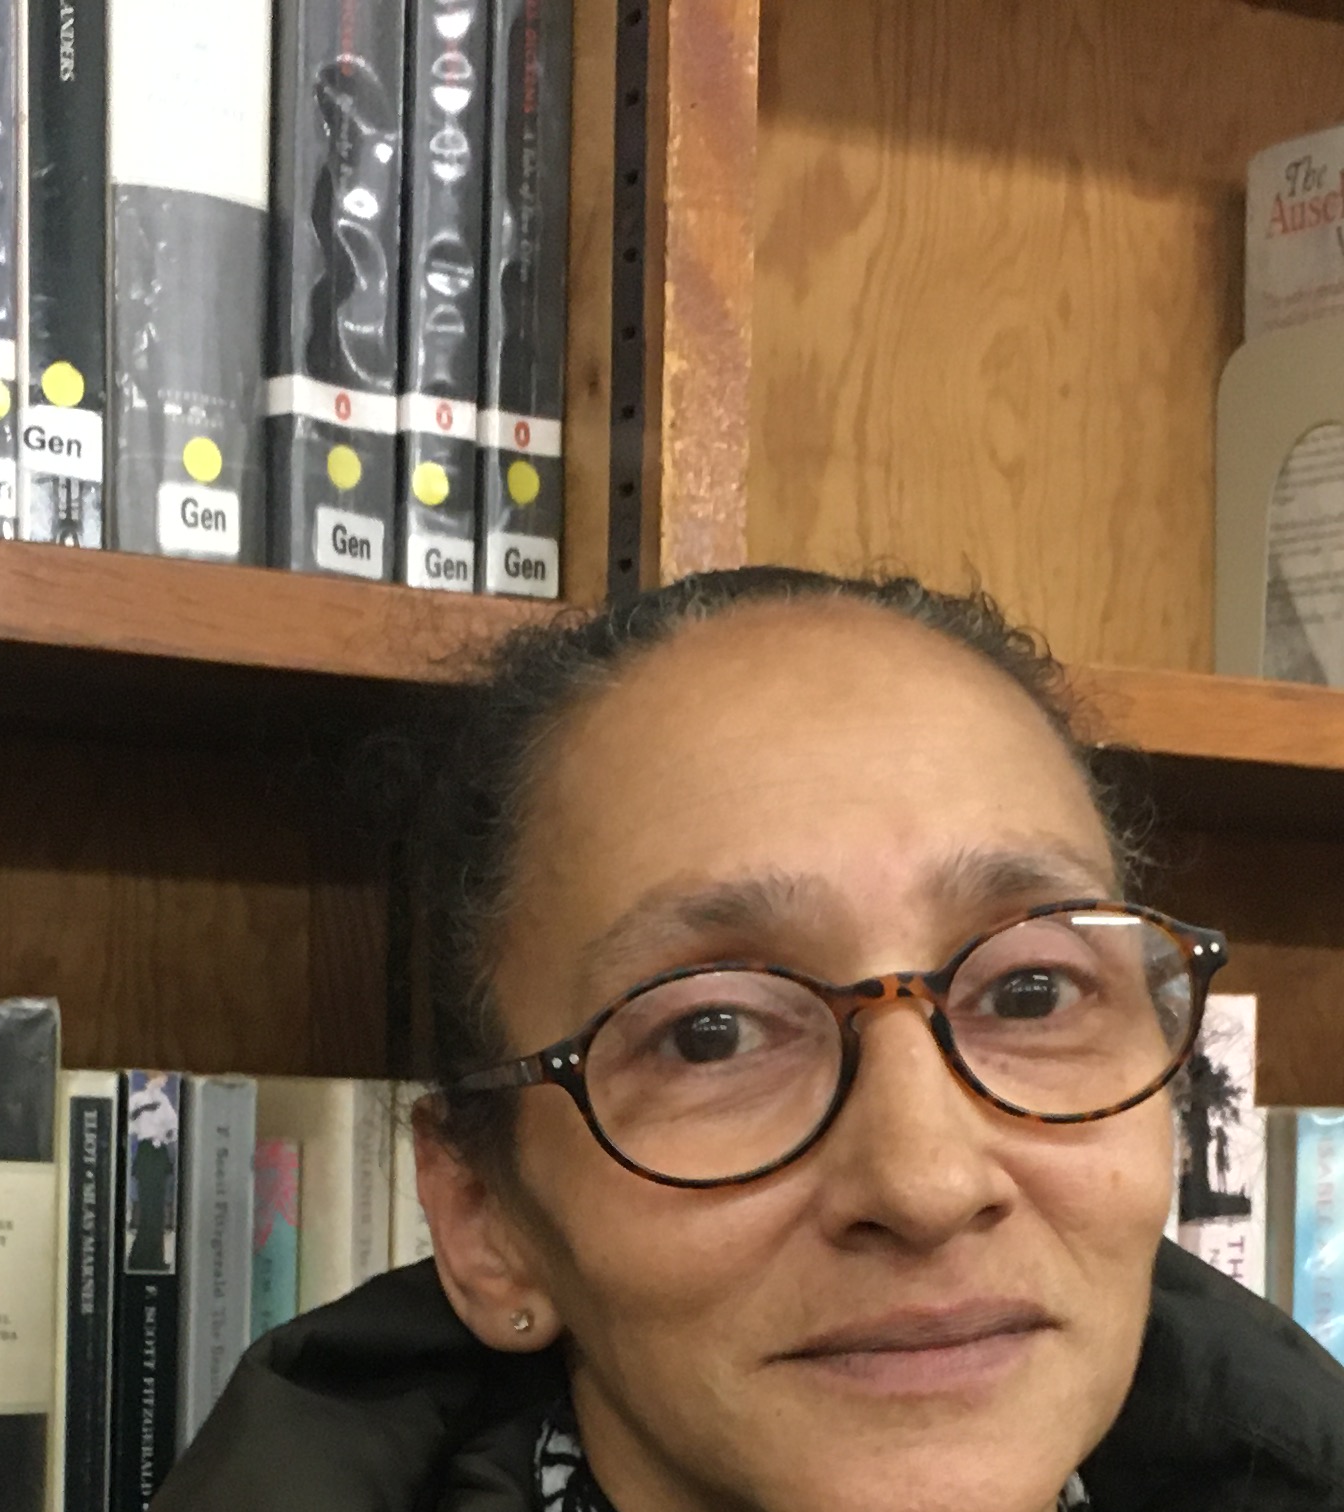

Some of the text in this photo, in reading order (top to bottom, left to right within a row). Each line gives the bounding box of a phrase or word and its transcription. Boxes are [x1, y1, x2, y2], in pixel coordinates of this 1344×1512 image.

[23, 425, 82, 459] Gen
[180, 498, 228, 534] Gen
[331, 525, 372, 561] Gen
[424, 548, 469, 582] Gen
[503, 547, 547, 581] Gen
[79, 1110, 98, 1315] ELIOT SILAS MARNER
[208, 1201, 229, 1299] Fitzgerald
[139, 1284, 158, 1496] F. SCOTT FITZGERALD
